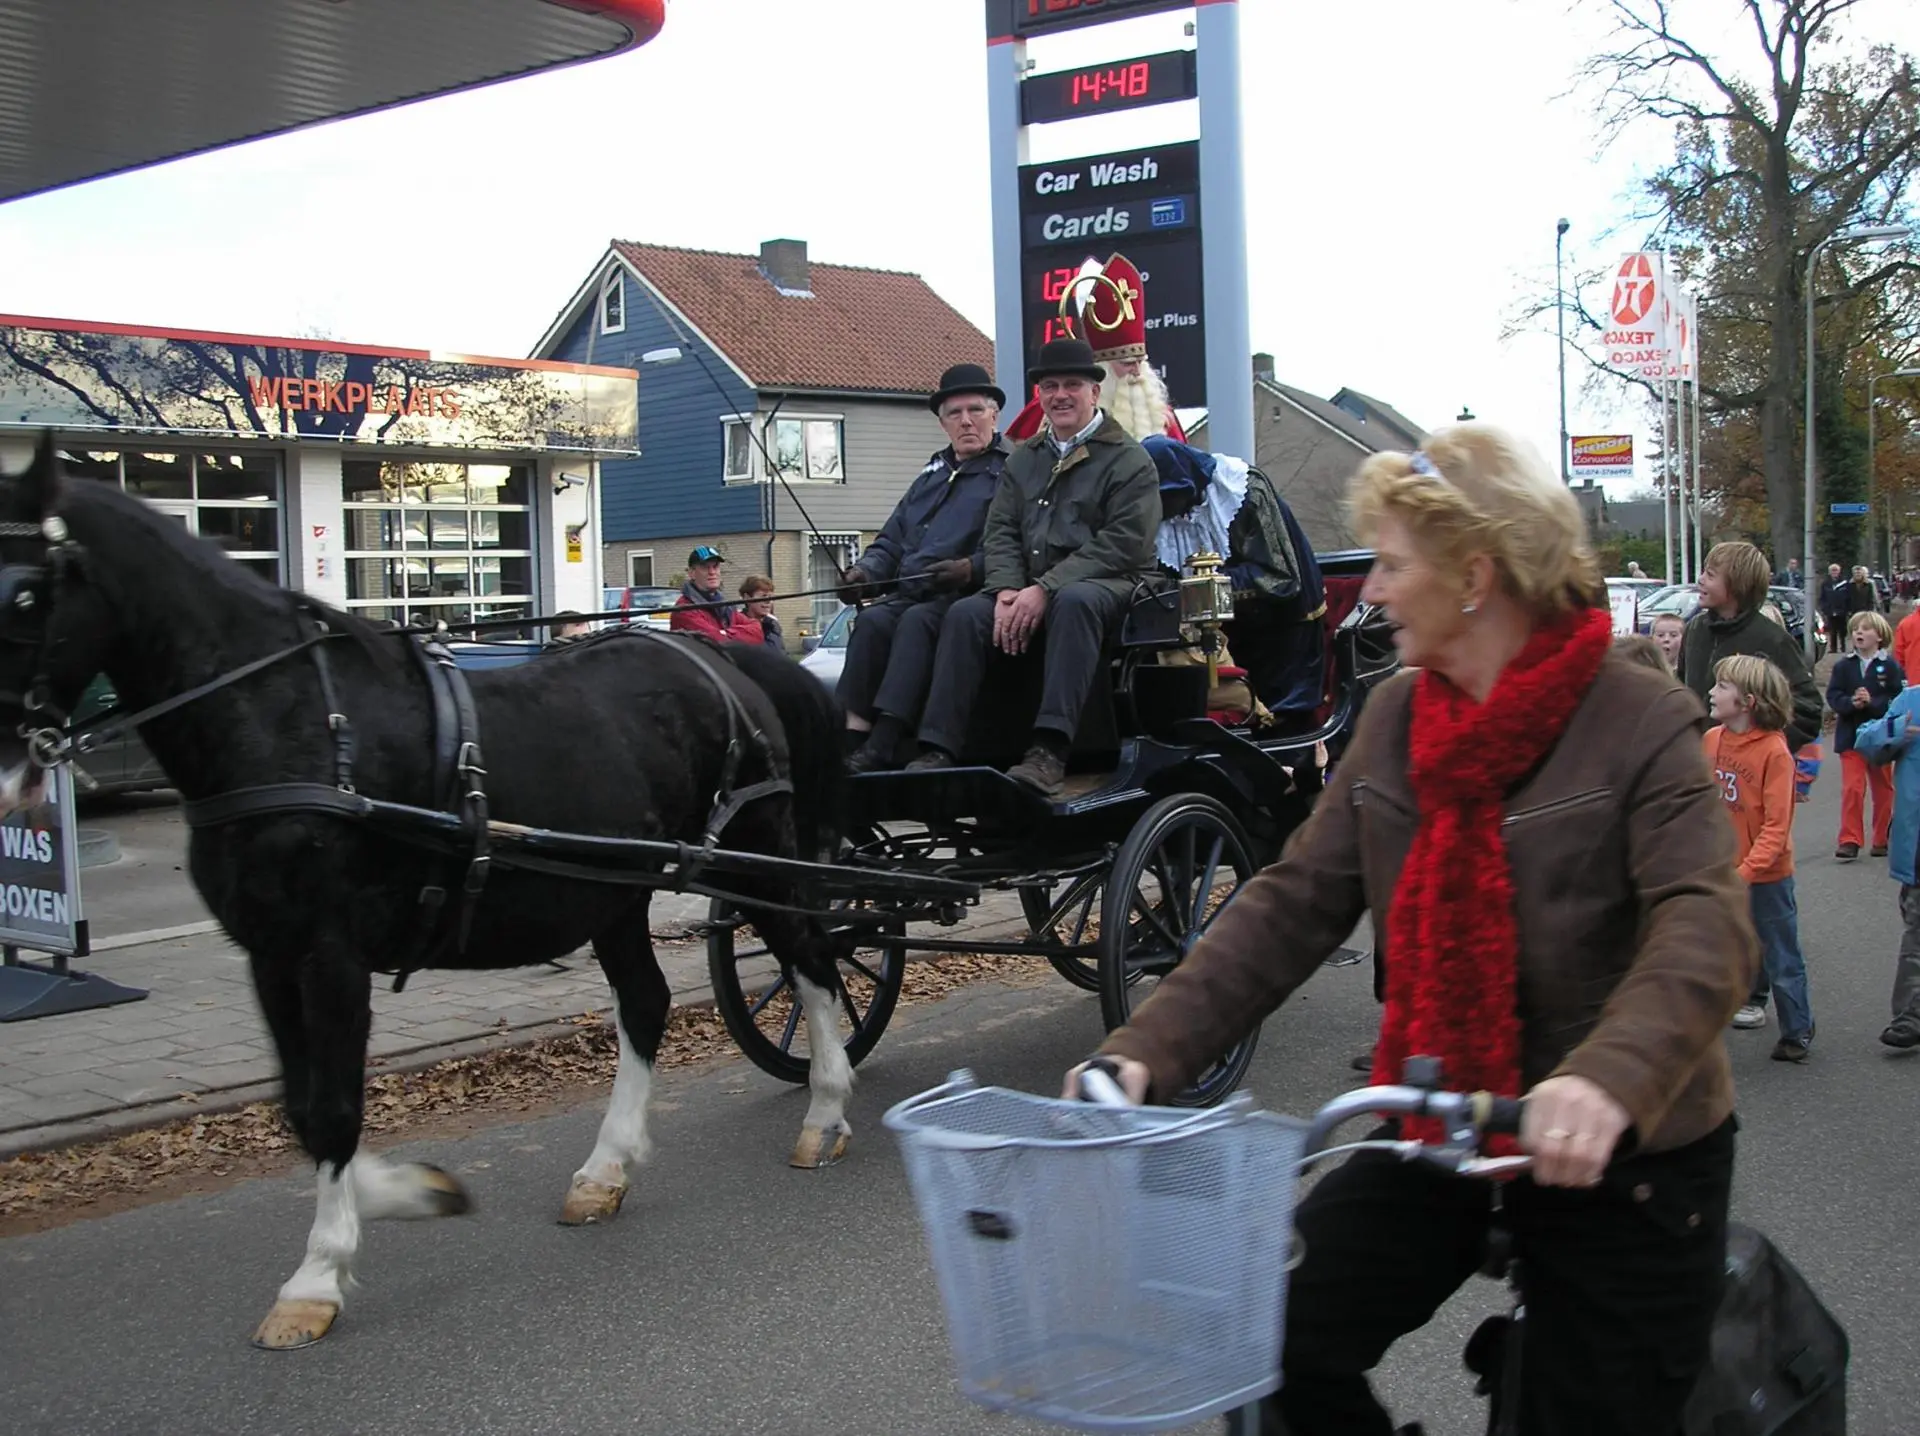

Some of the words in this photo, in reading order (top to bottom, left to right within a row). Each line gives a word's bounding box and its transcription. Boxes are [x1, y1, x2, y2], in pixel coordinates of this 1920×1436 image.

[1072, 62, 1149, 104] 14:48
[1035, 171, 1081, 195] Car
[1090, 157, 1158, 187] Wash
[1043, 206, 1130, 240] Cards
[1164, 313, 1198, 328] Plus
[248, 375, 462, 420] WERKPLAATS
[1, 826, 52, 863] WAS
